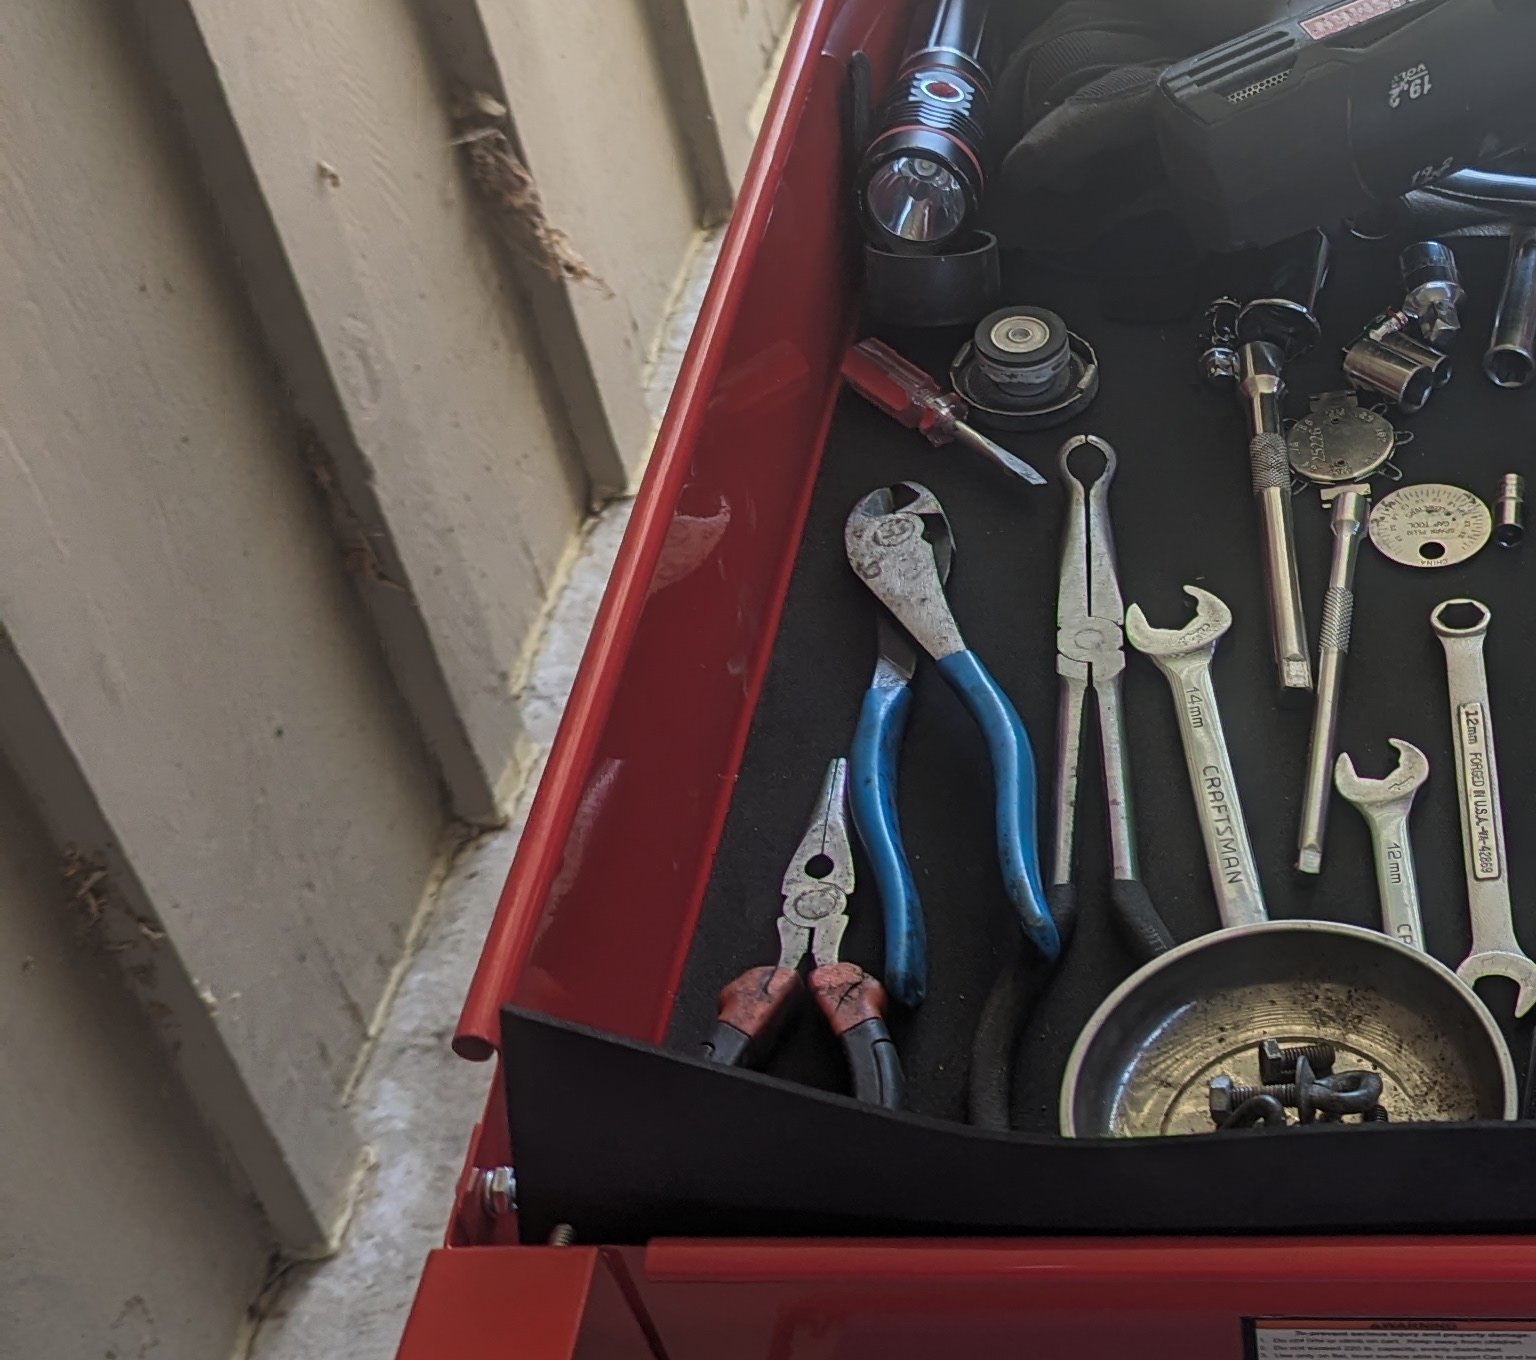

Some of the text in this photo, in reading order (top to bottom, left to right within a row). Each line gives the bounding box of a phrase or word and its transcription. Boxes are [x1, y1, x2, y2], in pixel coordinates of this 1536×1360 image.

[1309, 427, 1325, 461] 25226
[1465, 709, 1481, 745] 12mm
[1184, 685, 1245, 885] 14mm CRAFTSMAN
[1469, 752, 1485, 787] FORGED
[1473, 789, 1486, 798] IN
[1385, 841, 1403, 884] 12mm
